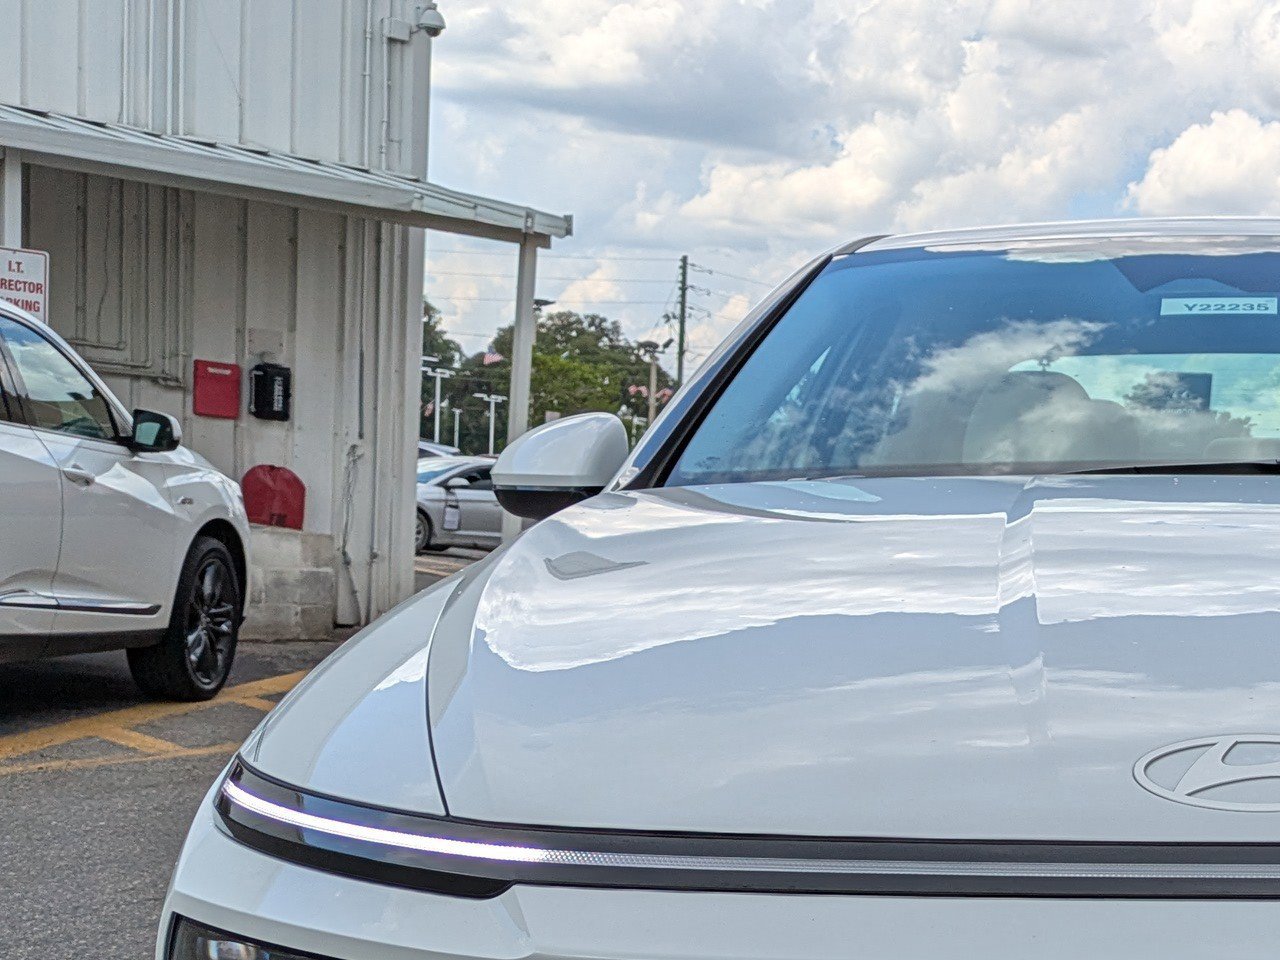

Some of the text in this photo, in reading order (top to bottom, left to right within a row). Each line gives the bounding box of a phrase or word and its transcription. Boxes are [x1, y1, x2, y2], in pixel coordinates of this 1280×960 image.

[8, 260, 24, 273] I.T.
[0, 278, 43, 294] RECTOR
[0, 296, 40, 312] KING
[1184, 303, 1269, 312] Y22235
